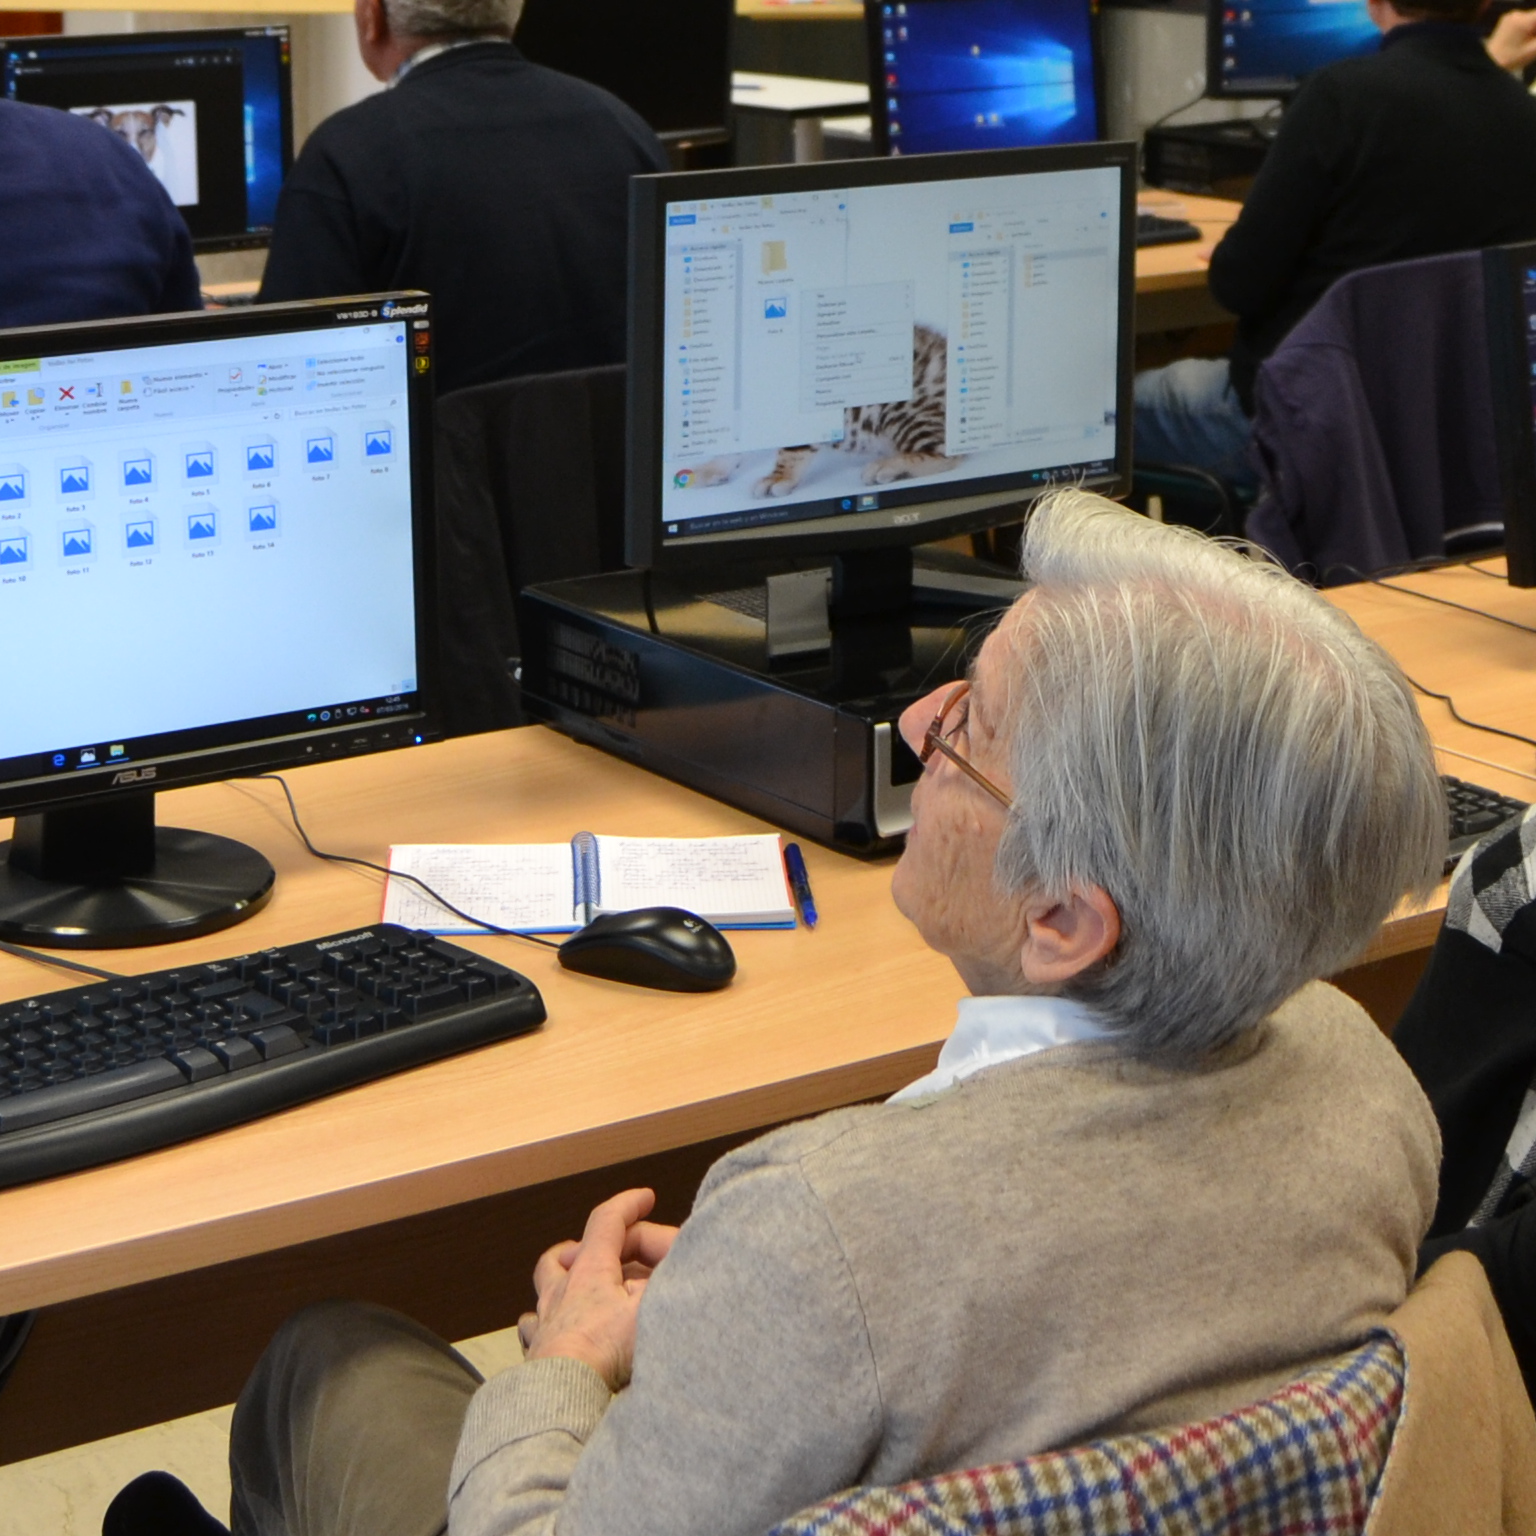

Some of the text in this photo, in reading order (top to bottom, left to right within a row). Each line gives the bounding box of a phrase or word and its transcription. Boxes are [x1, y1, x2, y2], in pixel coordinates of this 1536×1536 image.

[382, 303, 428, 318] Splendid
[893, 512, 920, 526] acer
[112, 767, 157, 785] ASUS
[316, 931, 374, 951] Microsoft
